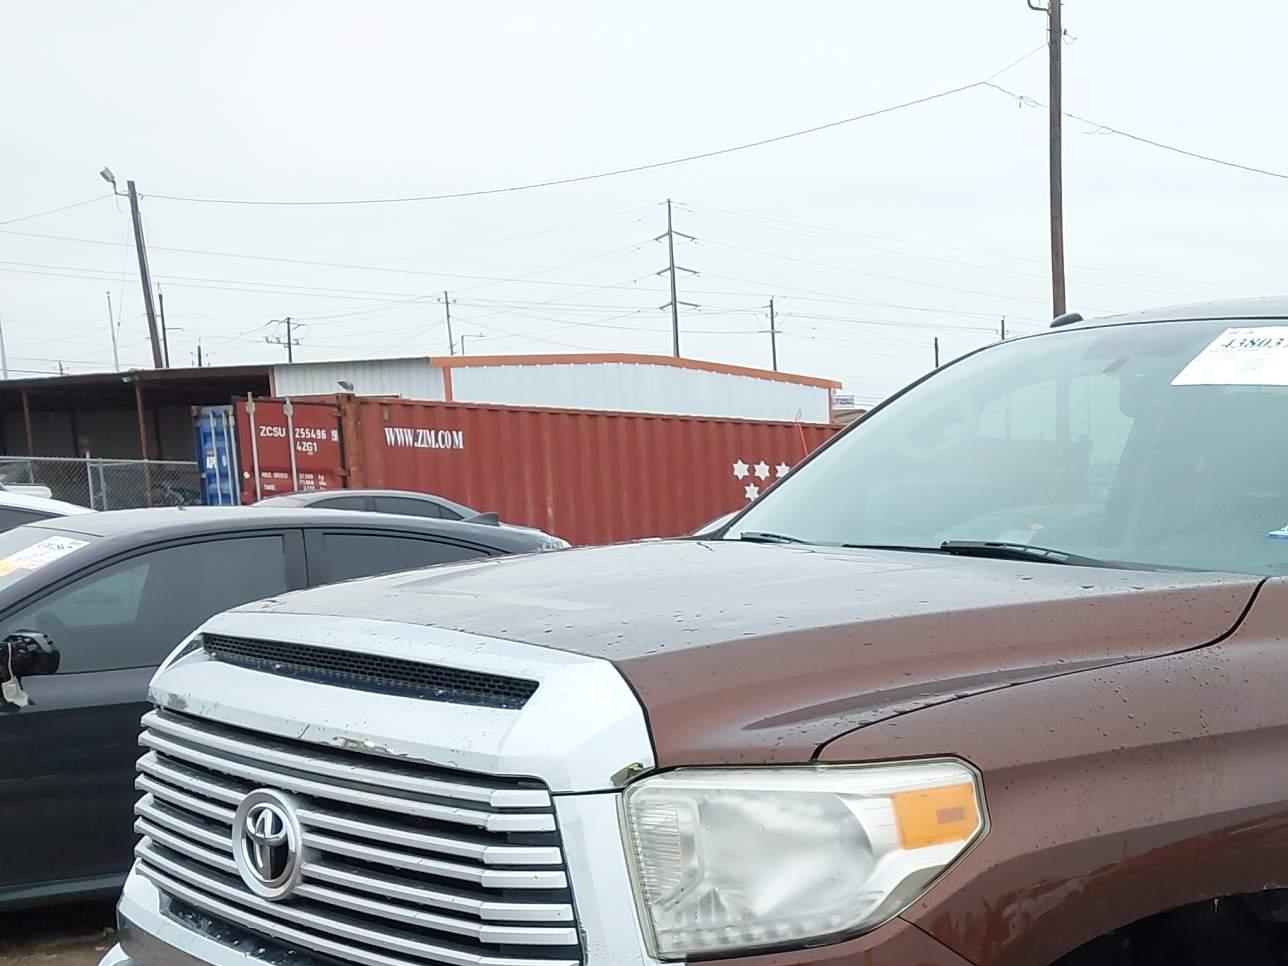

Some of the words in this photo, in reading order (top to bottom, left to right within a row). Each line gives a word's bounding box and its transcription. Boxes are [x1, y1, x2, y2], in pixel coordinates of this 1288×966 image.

[259, 426, 287, 438] ZCSU
[294, 427, 327, 440] 255496
[330, 429, 339, 442] 9
[383, 427, 465, 450] WWW.ZIM.COM
[296, 441, 318, 453] 42G1
